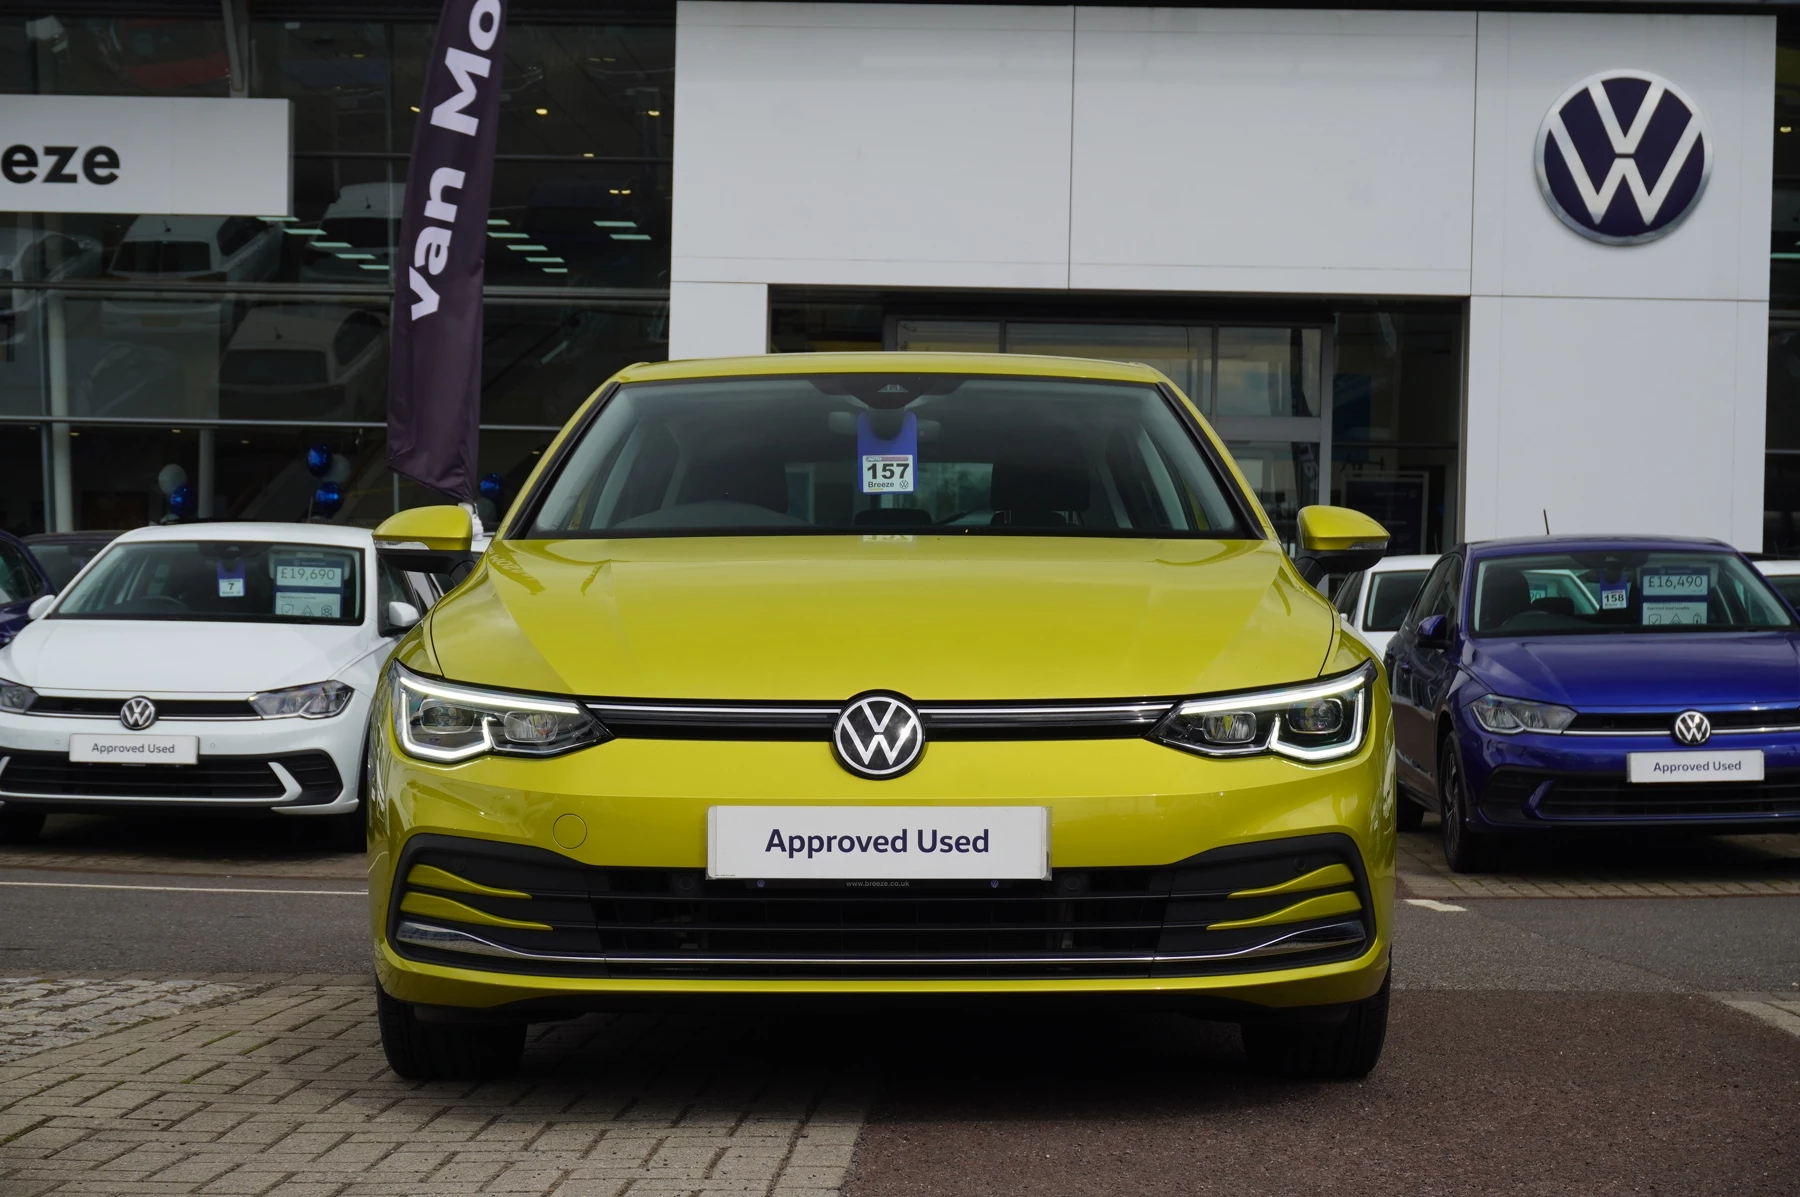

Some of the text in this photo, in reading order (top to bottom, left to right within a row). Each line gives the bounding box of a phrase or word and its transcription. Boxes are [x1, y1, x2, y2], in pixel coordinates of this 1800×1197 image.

[0, 144, 120, 186] eze
[867, 463, 910, 480] 157
[280, 567, 335, 582] £19,690
[228, 582, 235, 591] 7
[1648, 575, 1703, 590] £16,490
[1604, 593, 1625, 603] 158
[91, 743, 176, 755] Approved Used
[1653, 760, 1742, 775] Approved Used
[764, 828, 990, 859] Approved Used
